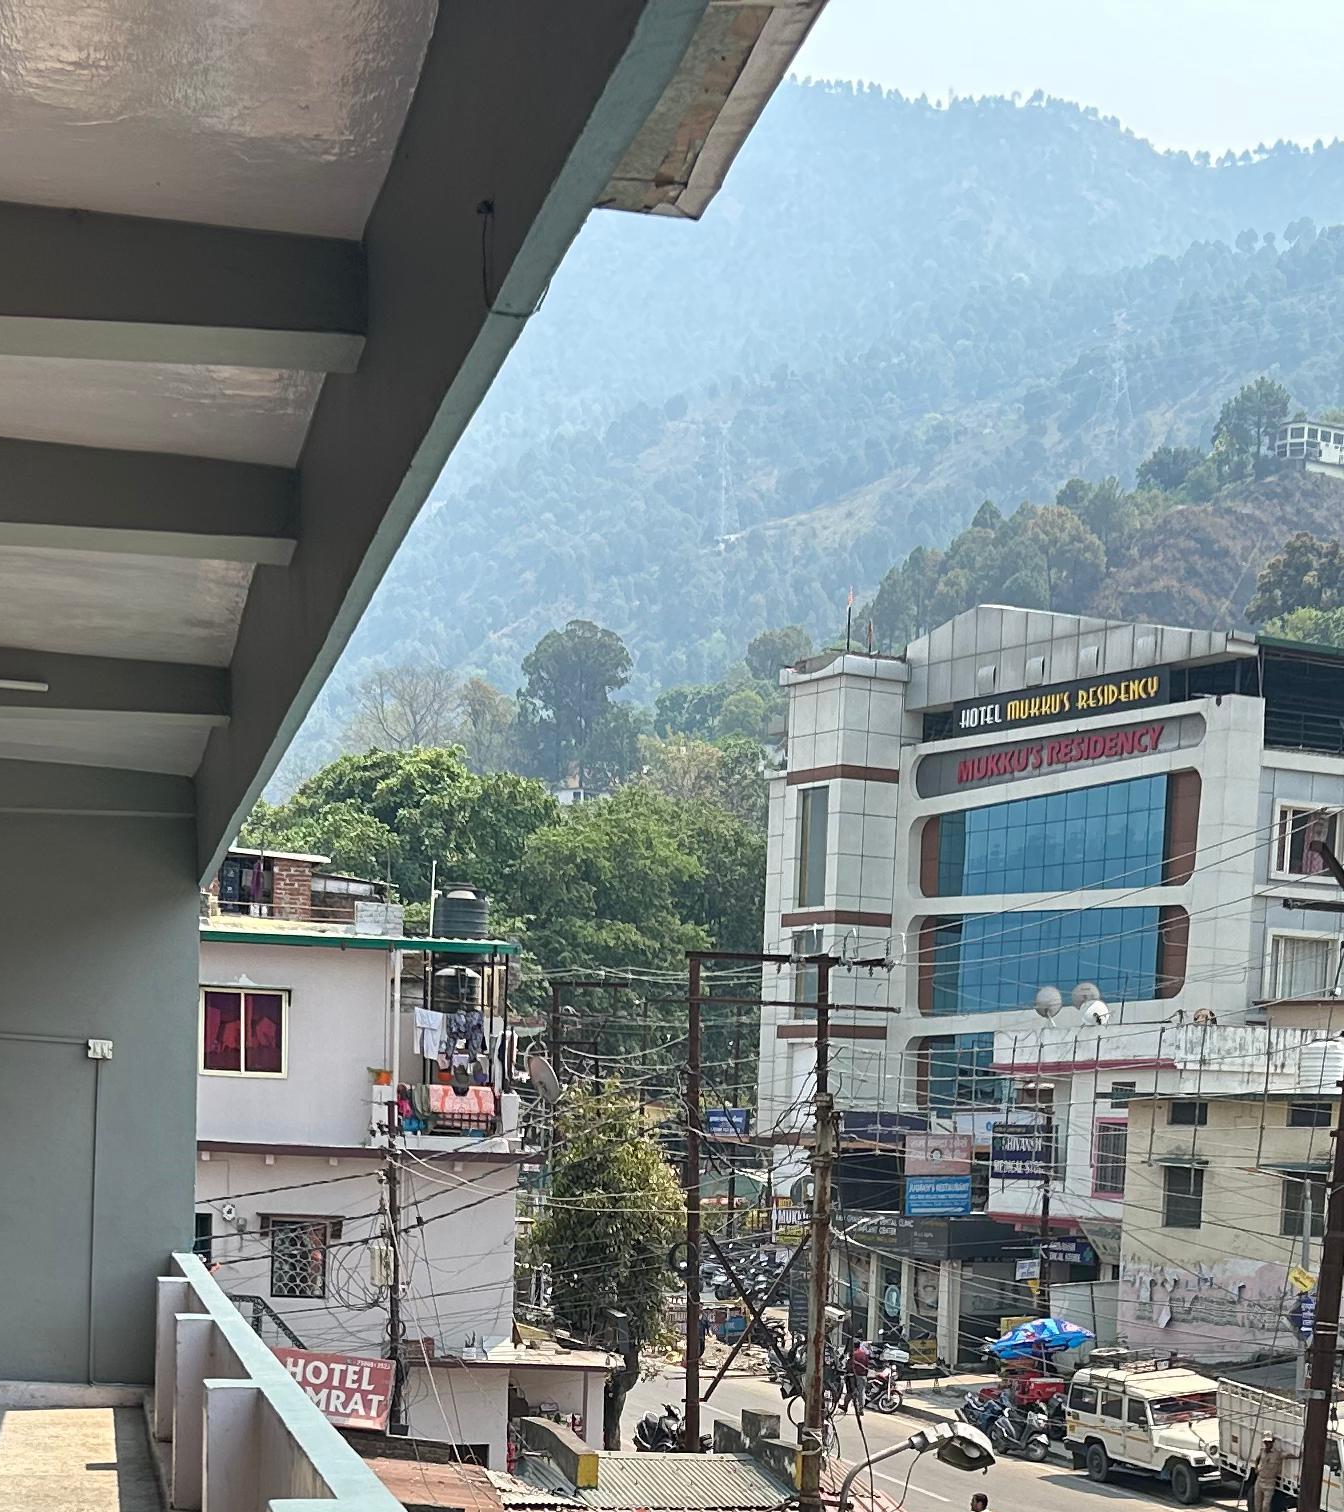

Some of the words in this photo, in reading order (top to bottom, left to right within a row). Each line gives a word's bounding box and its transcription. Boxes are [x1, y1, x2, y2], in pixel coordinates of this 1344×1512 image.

[959, 703, 1002, 729] HOTEL
[1006, 690, 1071, 721] MUKKU'S
[1075, 676, 1160, 711] RESIDENCY
[957, 743, 1044, 785] MUKKU'S
[1046, 724, 1165, 766] RESIDENCY
[285, 1356, 376, 1391] HOTEL
[305, 1386, 385, 1418] MRAT
